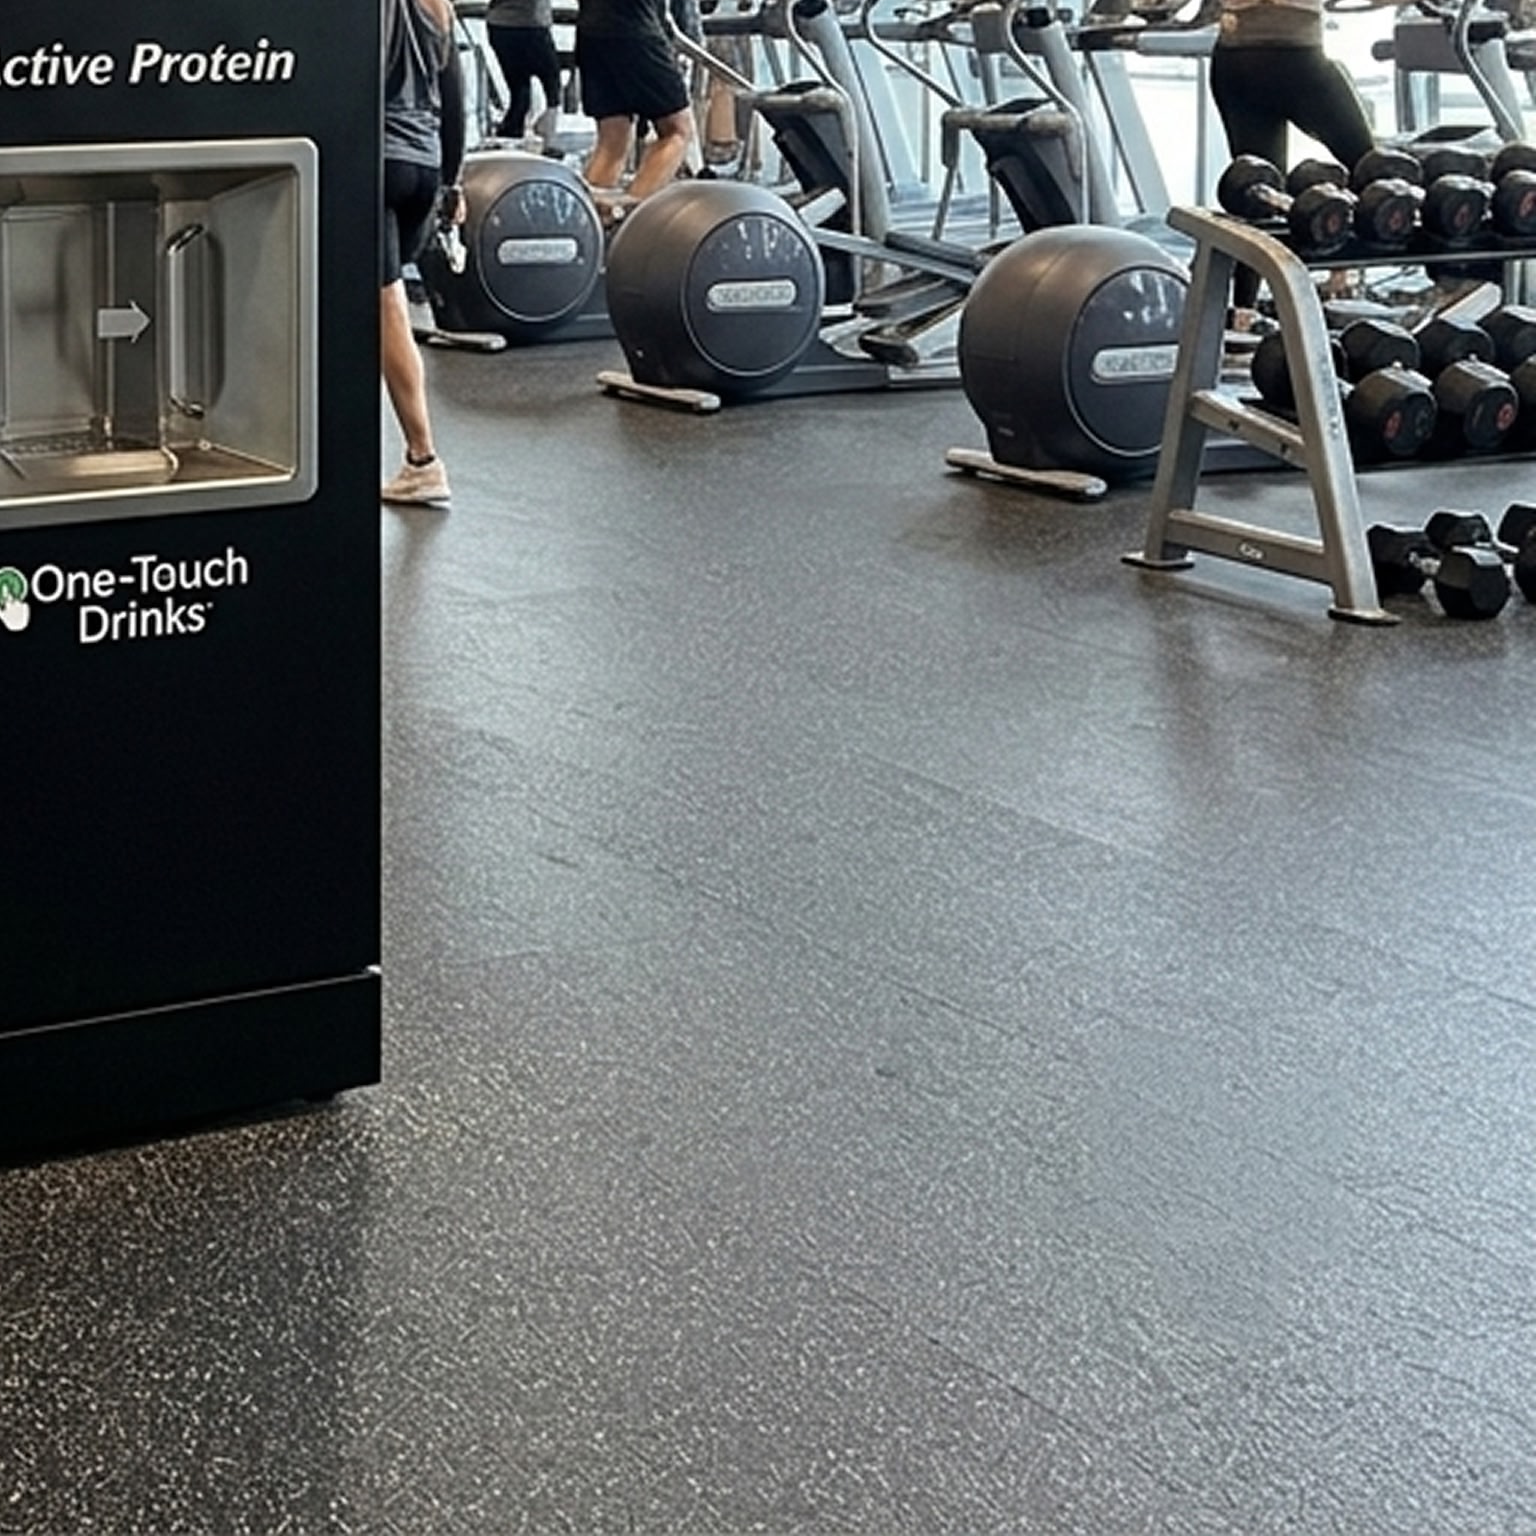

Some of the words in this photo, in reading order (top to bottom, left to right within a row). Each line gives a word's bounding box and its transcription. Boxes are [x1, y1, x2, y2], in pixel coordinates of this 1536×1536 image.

[128, 38, 296, 85] Protein
[30, 546, 249, 603] One-Touch
[79, 596, 207, 644] Drinks
